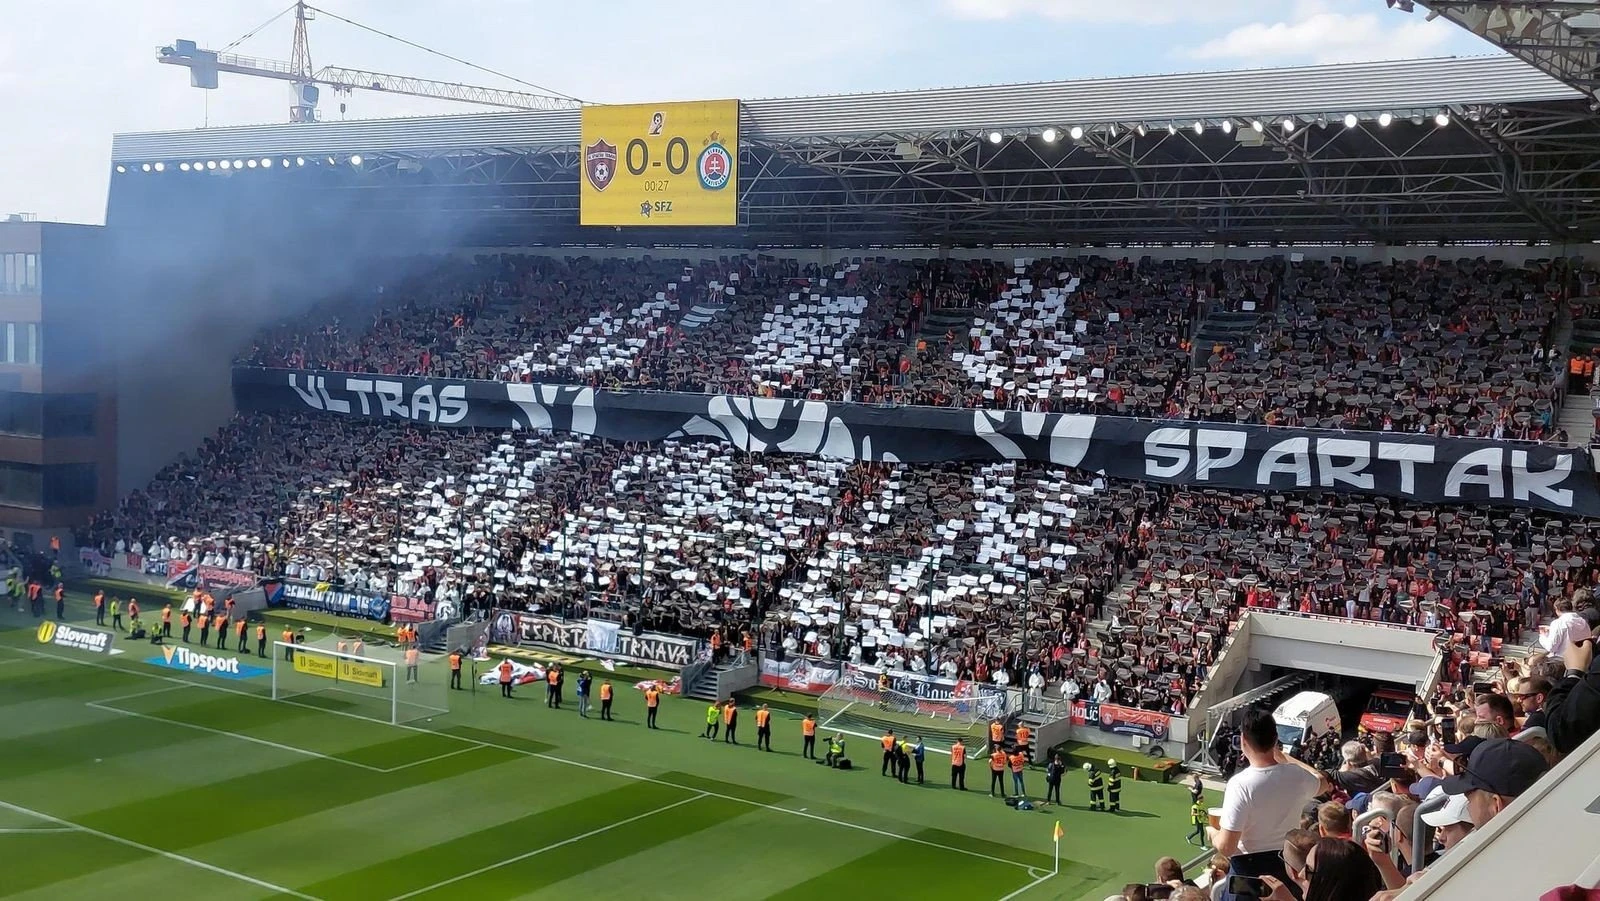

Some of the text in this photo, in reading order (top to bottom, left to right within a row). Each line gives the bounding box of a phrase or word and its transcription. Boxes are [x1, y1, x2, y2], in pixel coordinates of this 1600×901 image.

[644, 180, 669, 192] 00:27
[654, 201, 673, 212] SFZ
[288, 373, 469, 424] ULTRAS
[1144, 428, 1574, 508] SPARTAK
[55, 625, 108, 647] Slovnaft
[533, 624, 590, 649] SPARTA
[620, 636, 690, 665] TRNAVA
[176, 646, 240, 674] Tipsport
[308, 658, 333, 671] Slovnaft
[352, 666, 378, 679] Slovnaft
[1071, 705, 1099, 722] HOLÍČ
